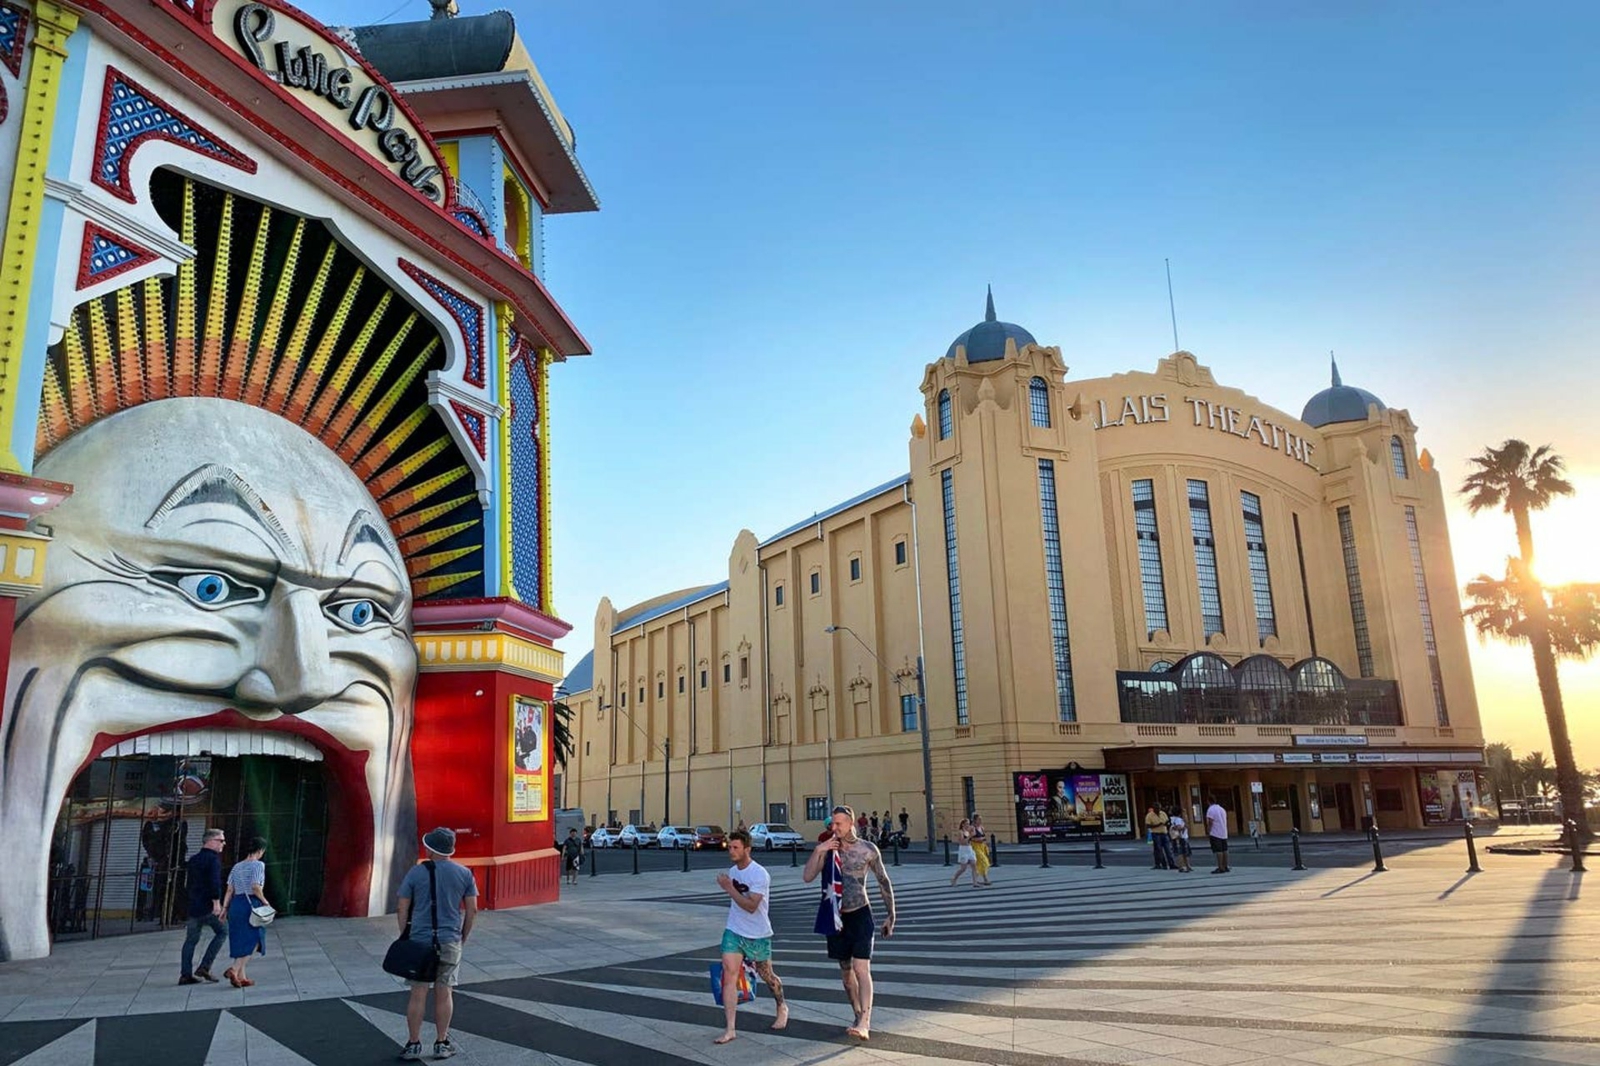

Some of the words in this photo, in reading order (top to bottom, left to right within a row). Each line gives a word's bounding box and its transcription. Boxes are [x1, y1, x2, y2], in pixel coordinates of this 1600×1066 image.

[234, 3, 353, 109] Luna
[349, 84, 443, 202] Park
[1093, 394, 1170, 430] LAIS
[1184, 396, 1320, 471] THEATRE
[1102, 786, 1126, 796] MOSS
[1105, 777, 1121, 786] IAN
